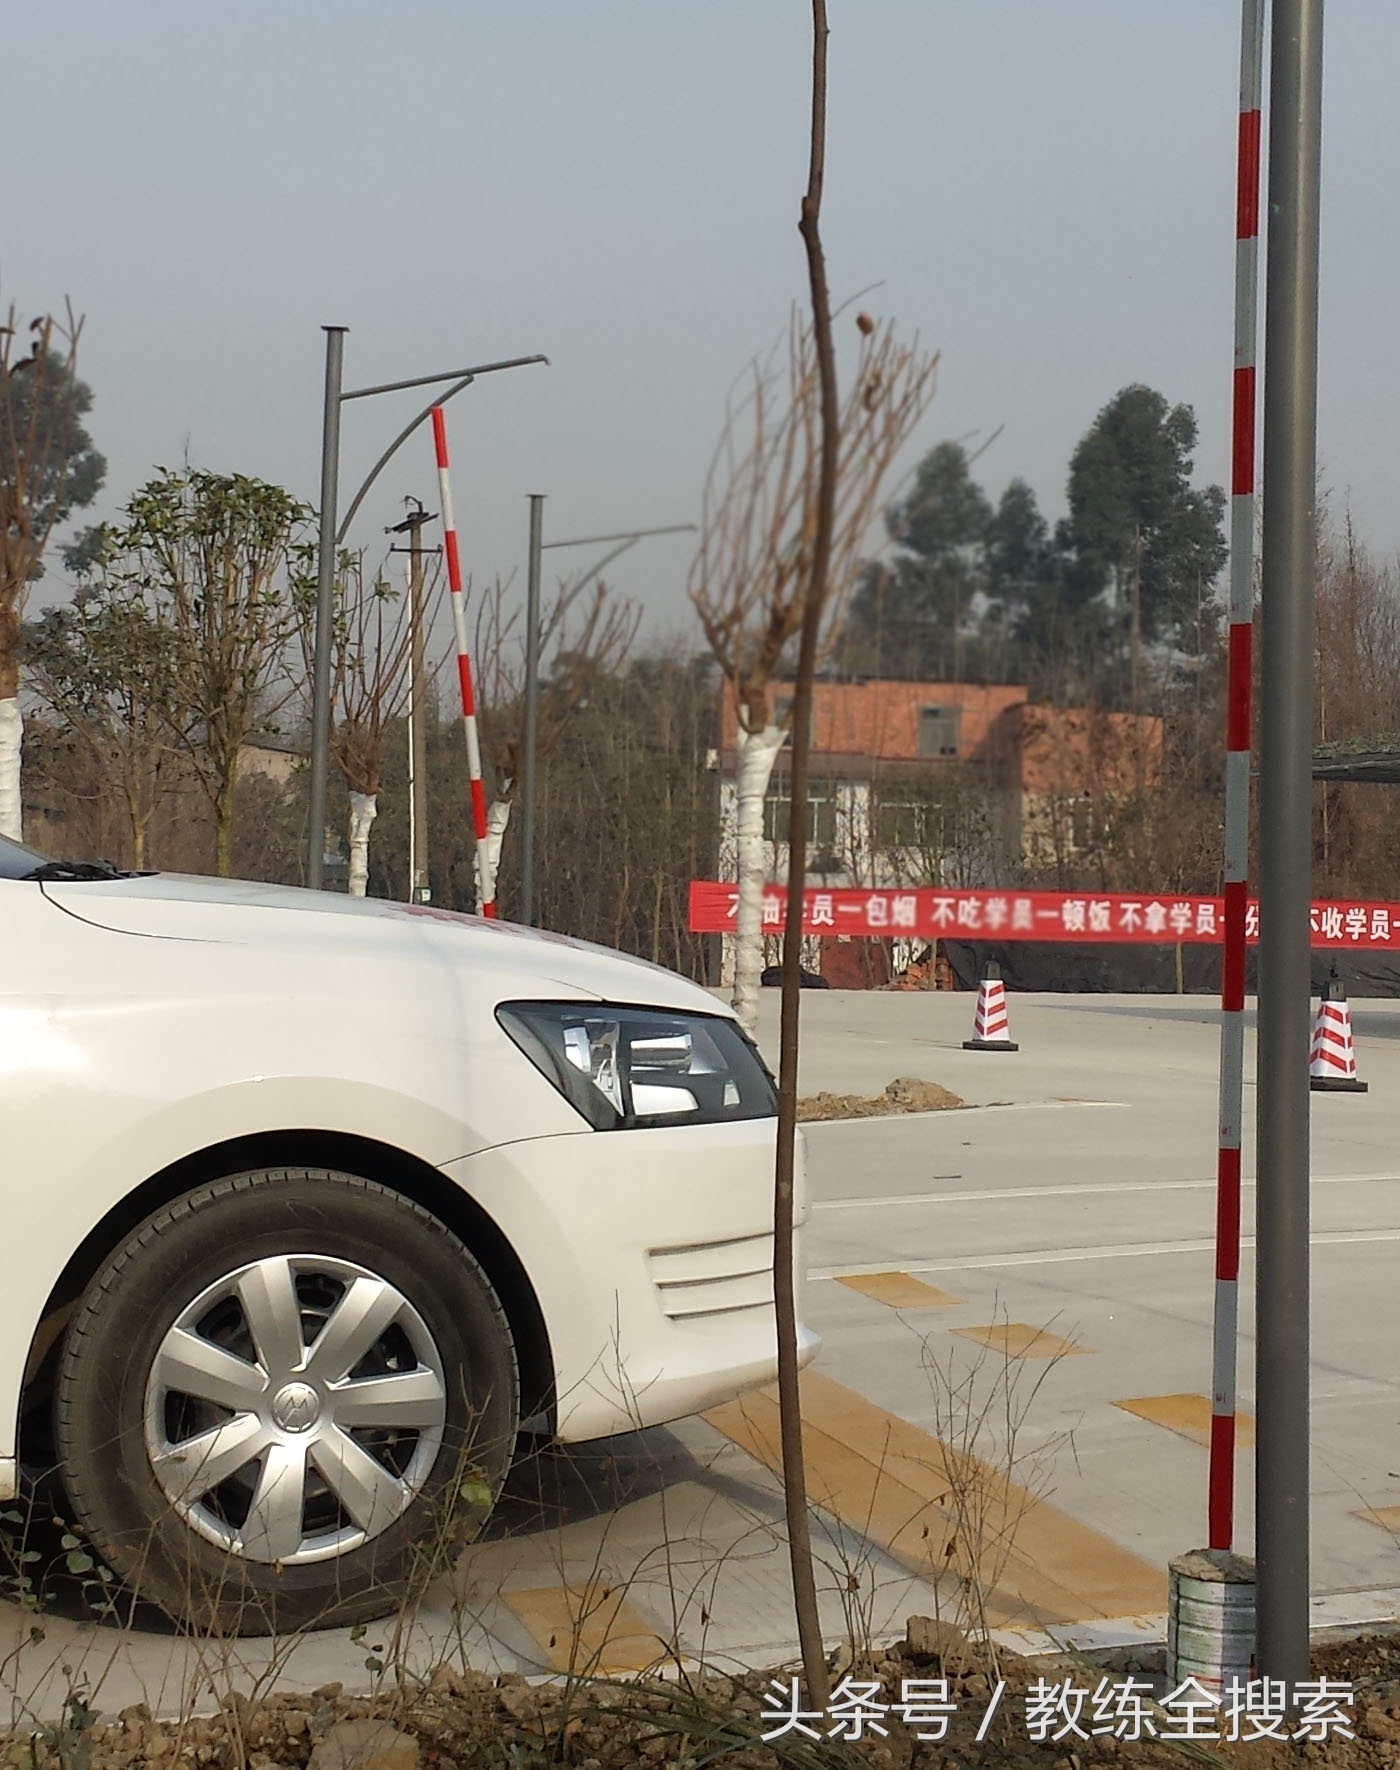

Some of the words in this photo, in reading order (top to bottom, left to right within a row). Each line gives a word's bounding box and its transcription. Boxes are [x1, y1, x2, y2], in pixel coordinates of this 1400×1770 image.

[727, 892, 917, 927] 抽员一包烟
[932, 897, 1111, 932] 不吃学员一顿饭
[1119, 901, 1259, 937] 不拿学员分
